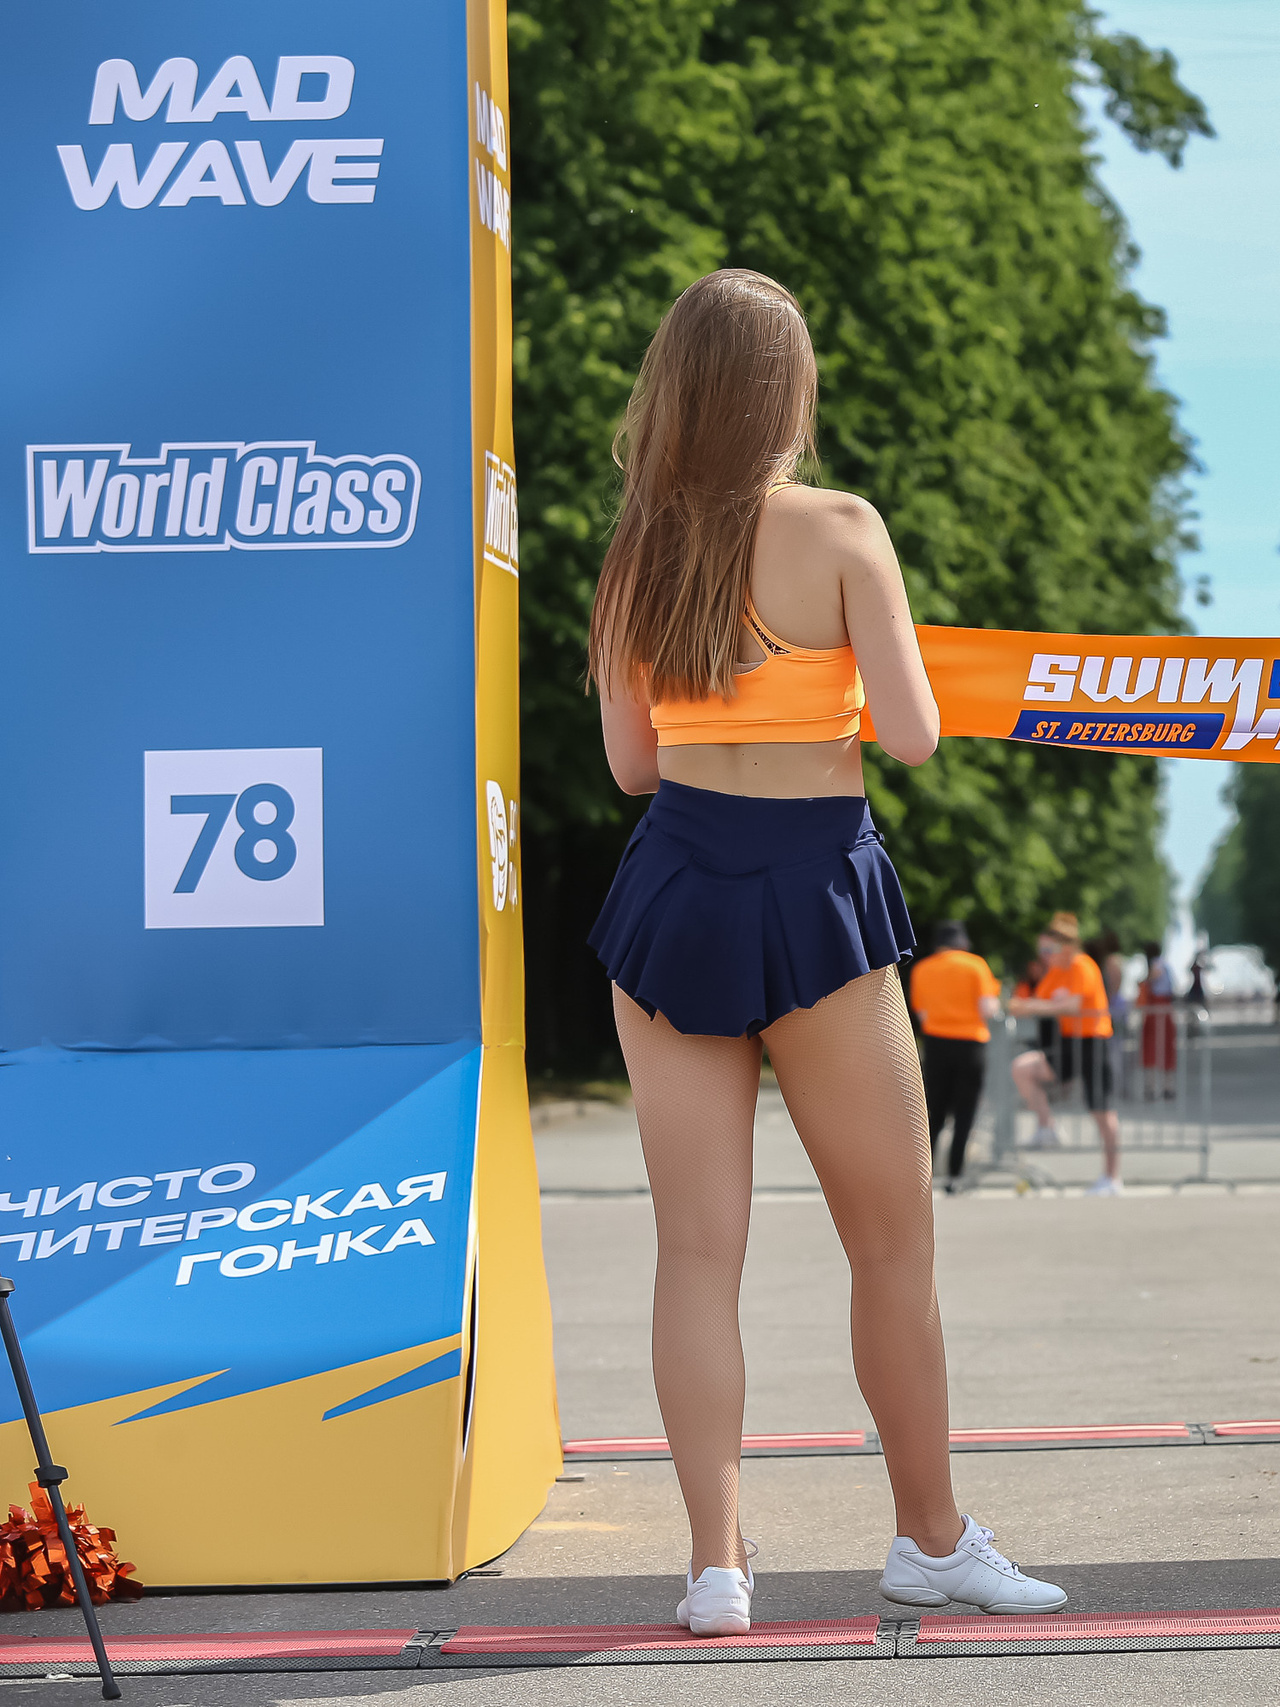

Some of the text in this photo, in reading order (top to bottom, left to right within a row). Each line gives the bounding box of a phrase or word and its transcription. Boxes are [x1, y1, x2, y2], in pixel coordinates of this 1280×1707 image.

[88, 56, 355, 125] MAD
[475, 81, 507, 172] MAD
[57, 138, 385, 211] WAVE
[42, 455, 407, 539] World Class
[1023, 653, 1264, 703] SWIM
[1031, 721, 1197, 743] ST. PETERSBURG
[169, 782, 297, 894] 78
[0, 1162, 256, 1218] ЧИСТО
[176, 1218, 436, 1286] ГОНКА
